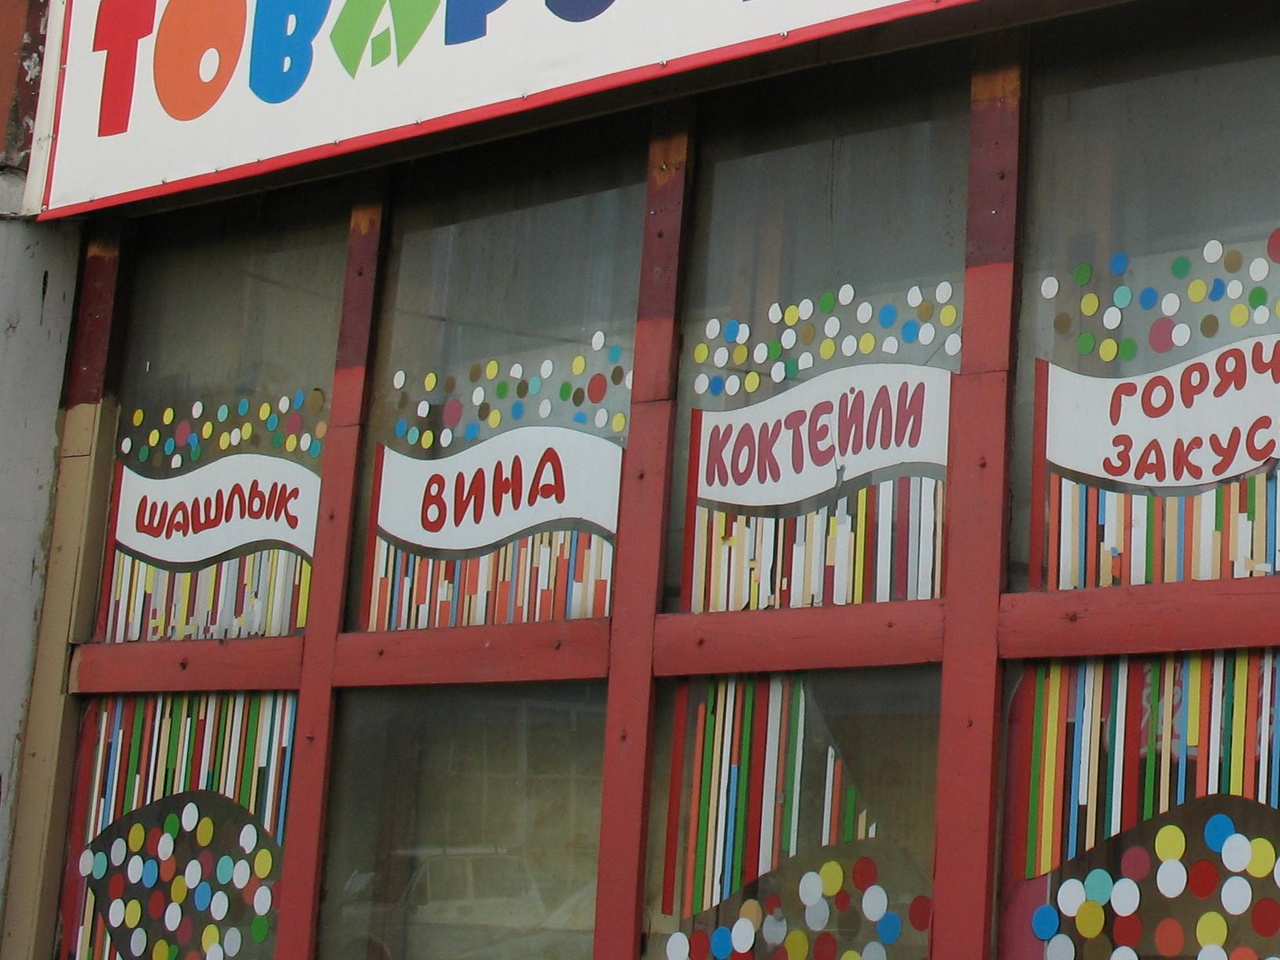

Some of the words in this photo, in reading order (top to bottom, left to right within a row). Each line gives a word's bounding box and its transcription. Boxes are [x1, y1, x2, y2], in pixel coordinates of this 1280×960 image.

[705, 381, 926, 487] КОКТЕЙЛИ
[136, 481, 299, 540] ШАШЛЫК
[420, 447, 567, 533] ВИНА
